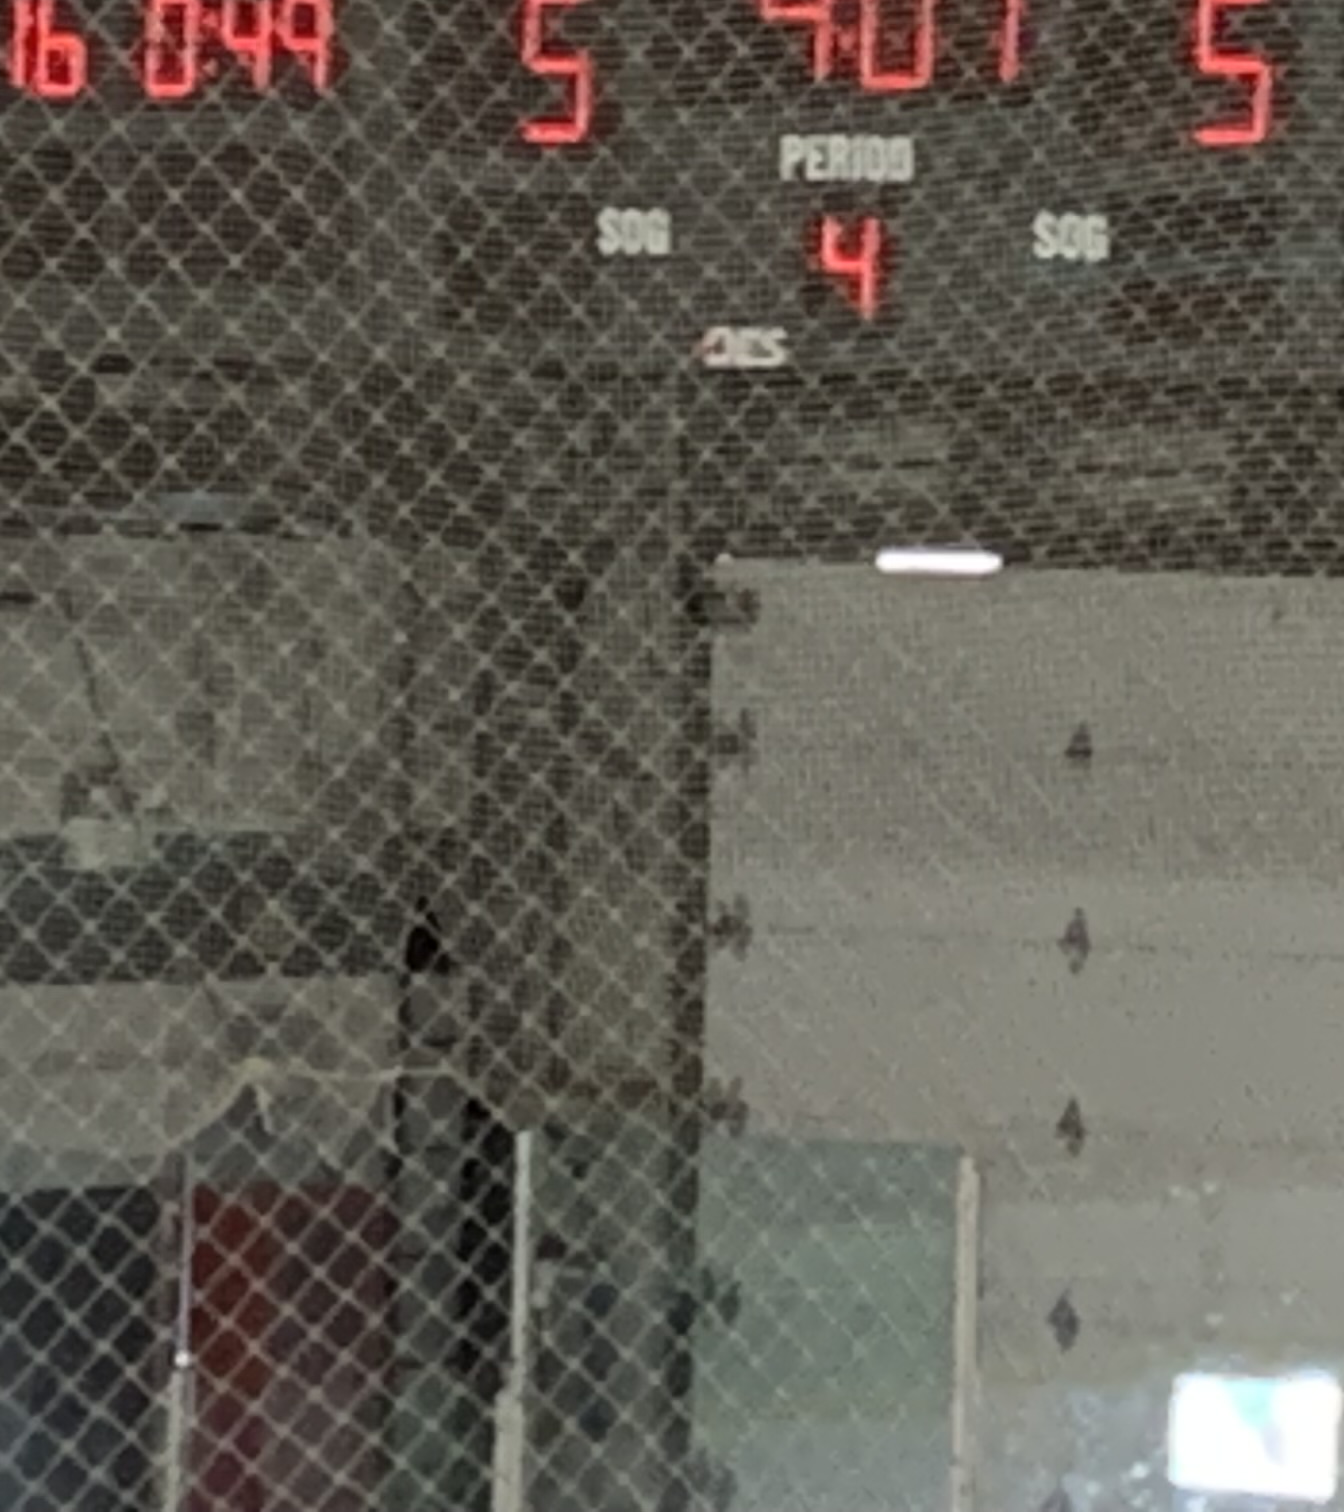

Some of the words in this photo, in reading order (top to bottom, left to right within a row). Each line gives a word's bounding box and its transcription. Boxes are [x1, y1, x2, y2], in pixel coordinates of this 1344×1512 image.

[778, 134, 915, 182] PERIOD
[596, 207, 671, 256] SOG
[1031, 210, 1111, 262] SOG
[820, 215, 880, 319] 4
